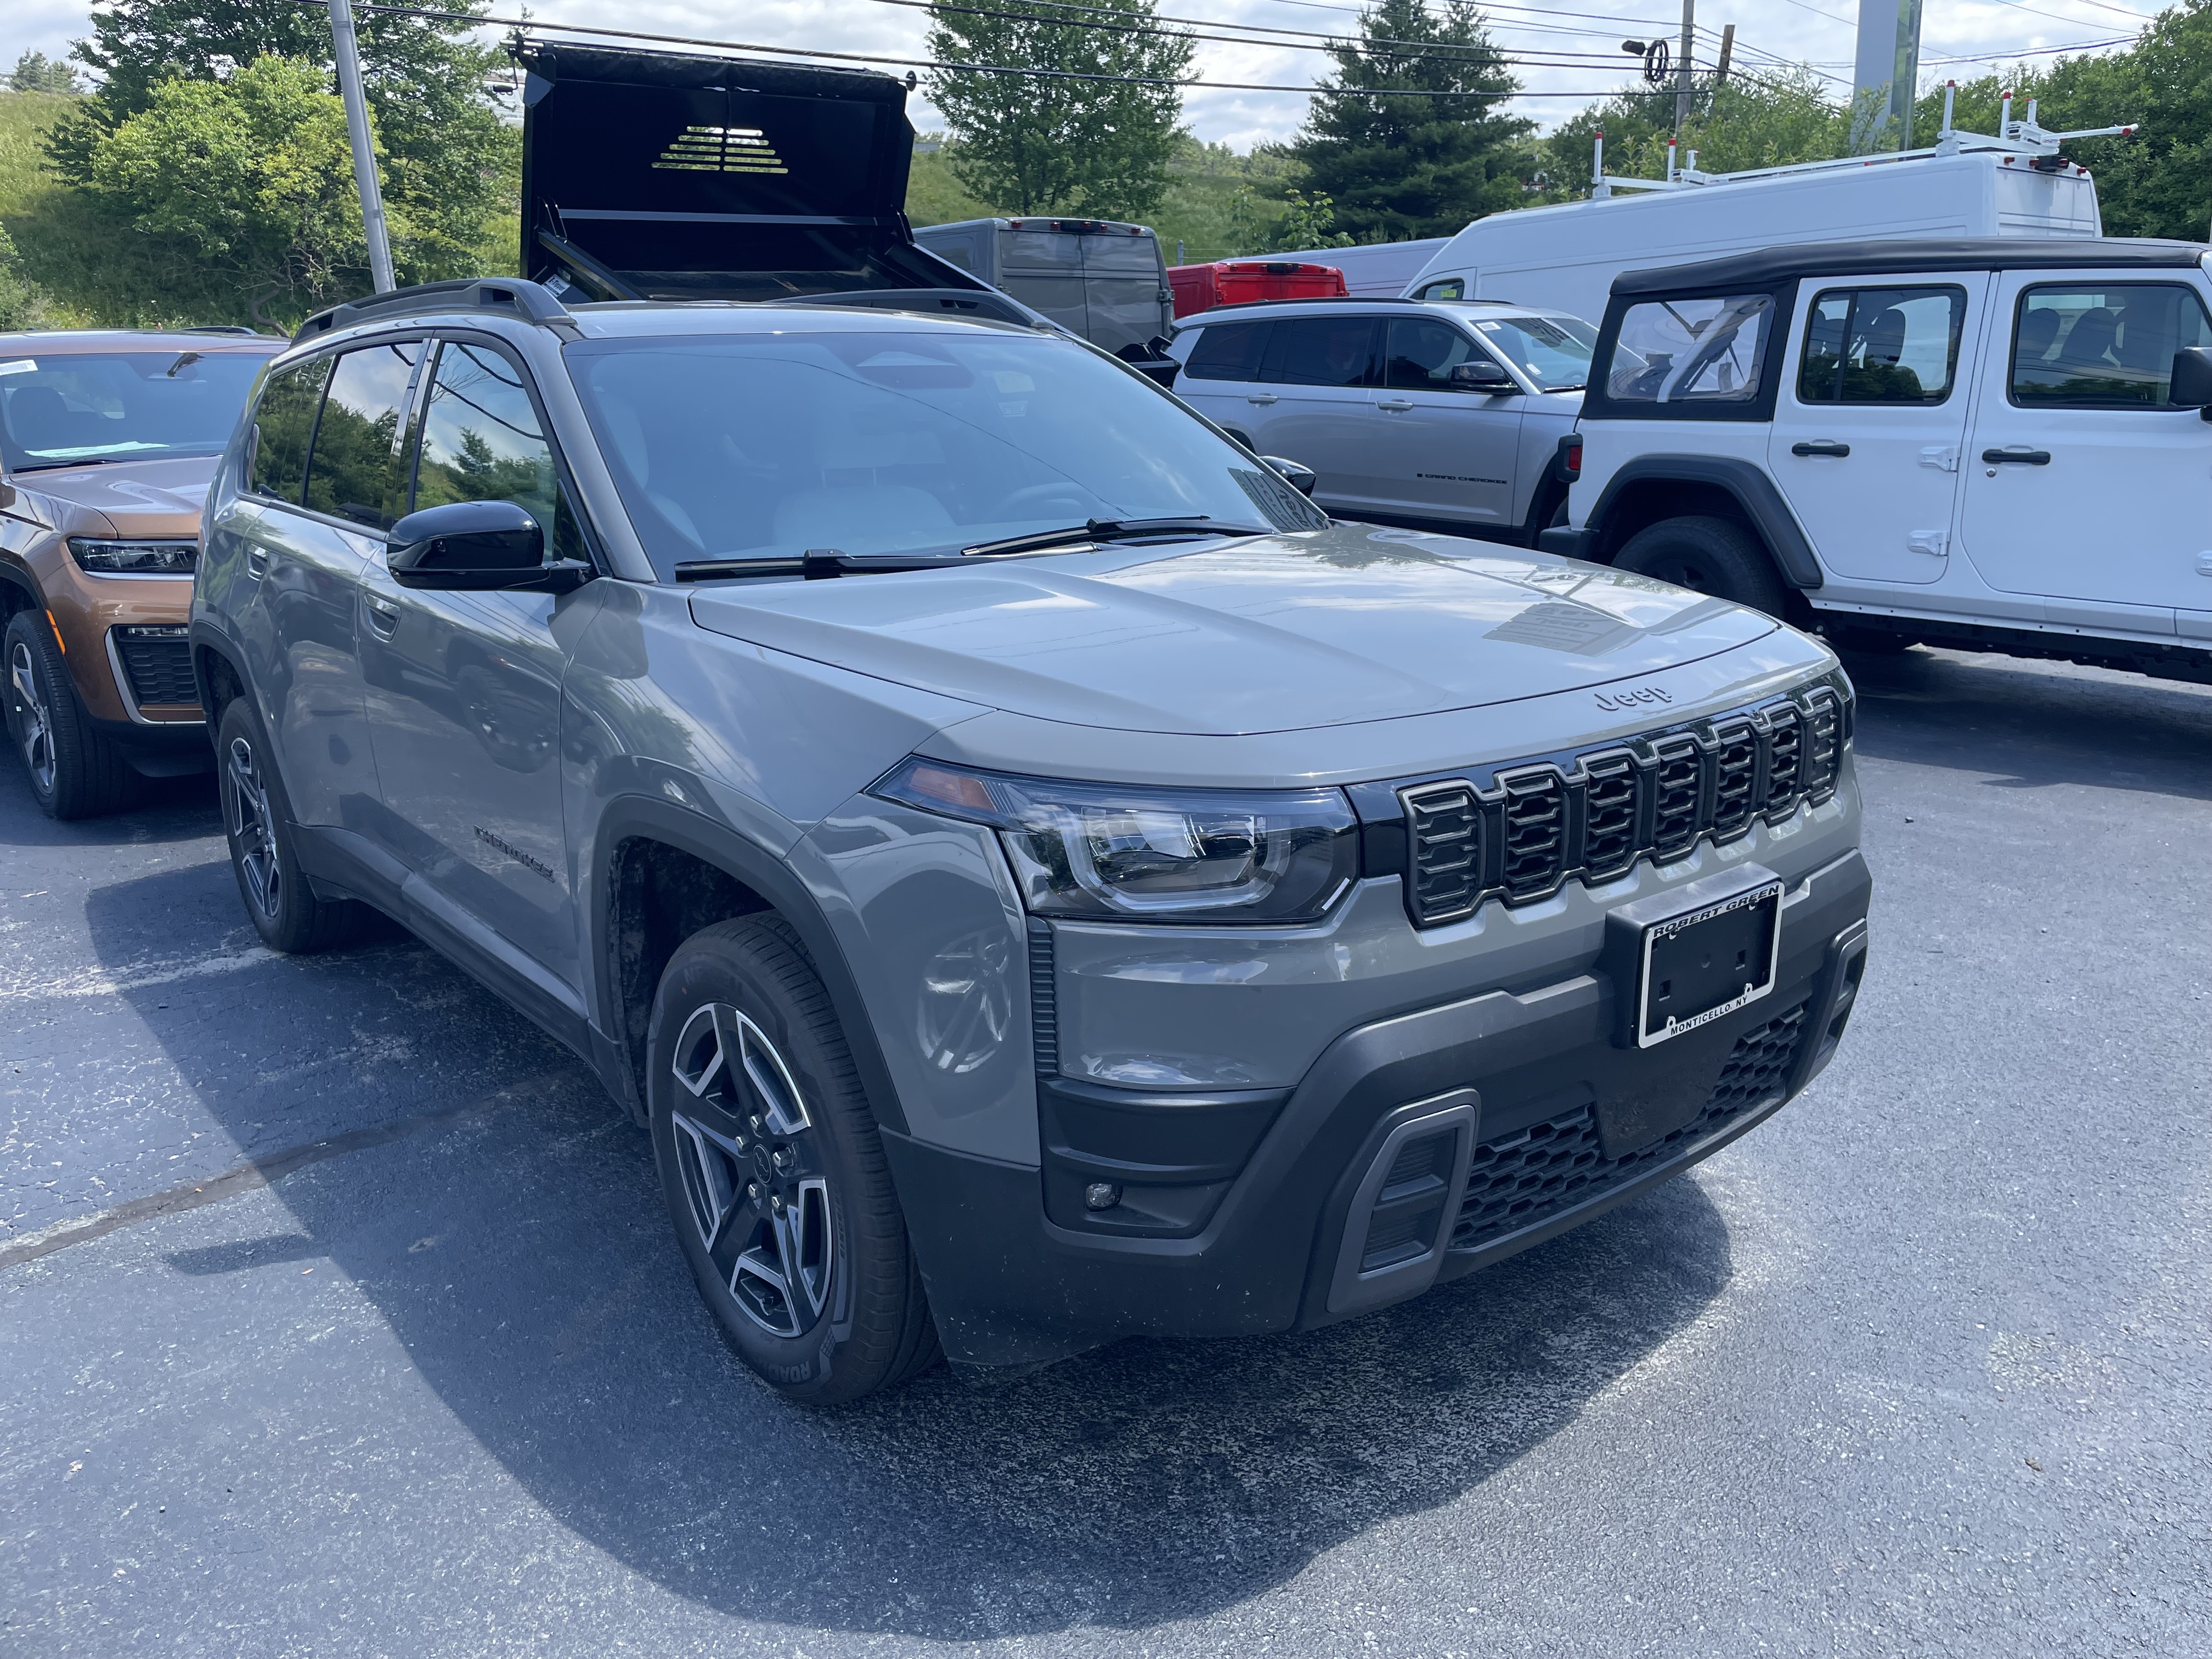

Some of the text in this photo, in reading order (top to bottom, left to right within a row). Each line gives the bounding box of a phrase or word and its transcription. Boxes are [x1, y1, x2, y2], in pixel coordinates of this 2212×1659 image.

[1458, 476, 1508, 484] CHEROKEE
[1594, 687, 1673, 711] Jeep
[473, 824, 555, 883] CHEROKEE
[1653, 884, 1780, 938] ROBERT GREEN
[1736, 995, 1748, 1007] NY
